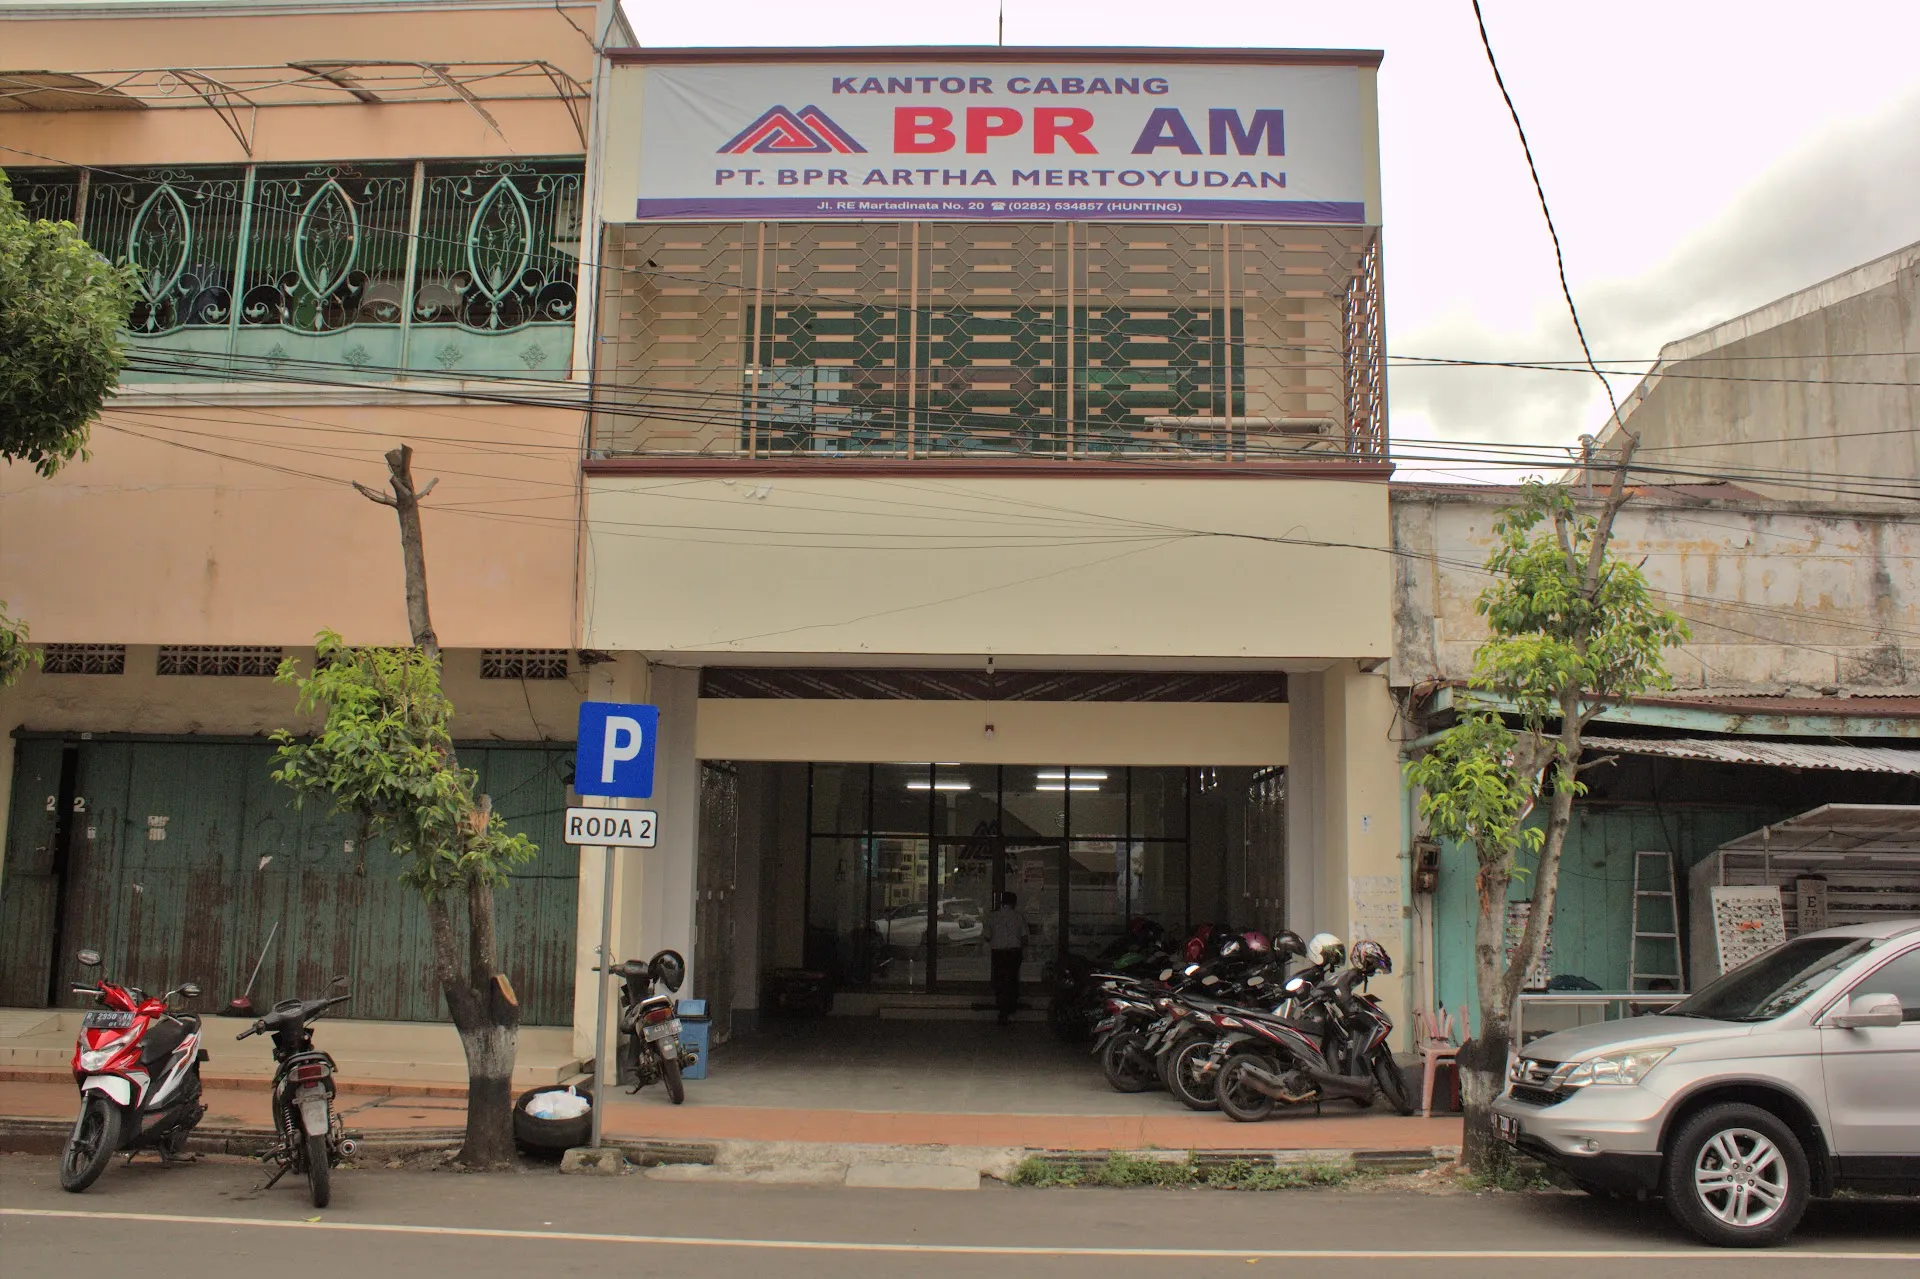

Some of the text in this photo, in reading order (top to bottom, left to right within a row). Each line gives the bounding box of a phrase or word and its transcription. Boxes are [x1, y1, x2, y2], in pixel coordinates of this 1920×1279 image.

[831, 76, 1170, 95] KANTOR CABANG
[893, 106, 1286, 156] BPR AM
[715, 169, 1287, 189] PT. BPR ARTHA MERTOYUDAN
[837, 201, 856, 210] RE
[859, 201, 939, 211] Martadinata
[943, 201, 964, 211] No.
[968, 202, 985, 211] 20
[1008, 202, 1051, 212] (0282)
[1054, 202, 1104, 212] 534857
[1107, 202, 1183, 213] (HUNTING)
[601, 715, 643, 784] P
[46, 795, 56, 812] 2
[73, 796, 86, 813] 2
[570, 816, 652, 839] RODA 2
